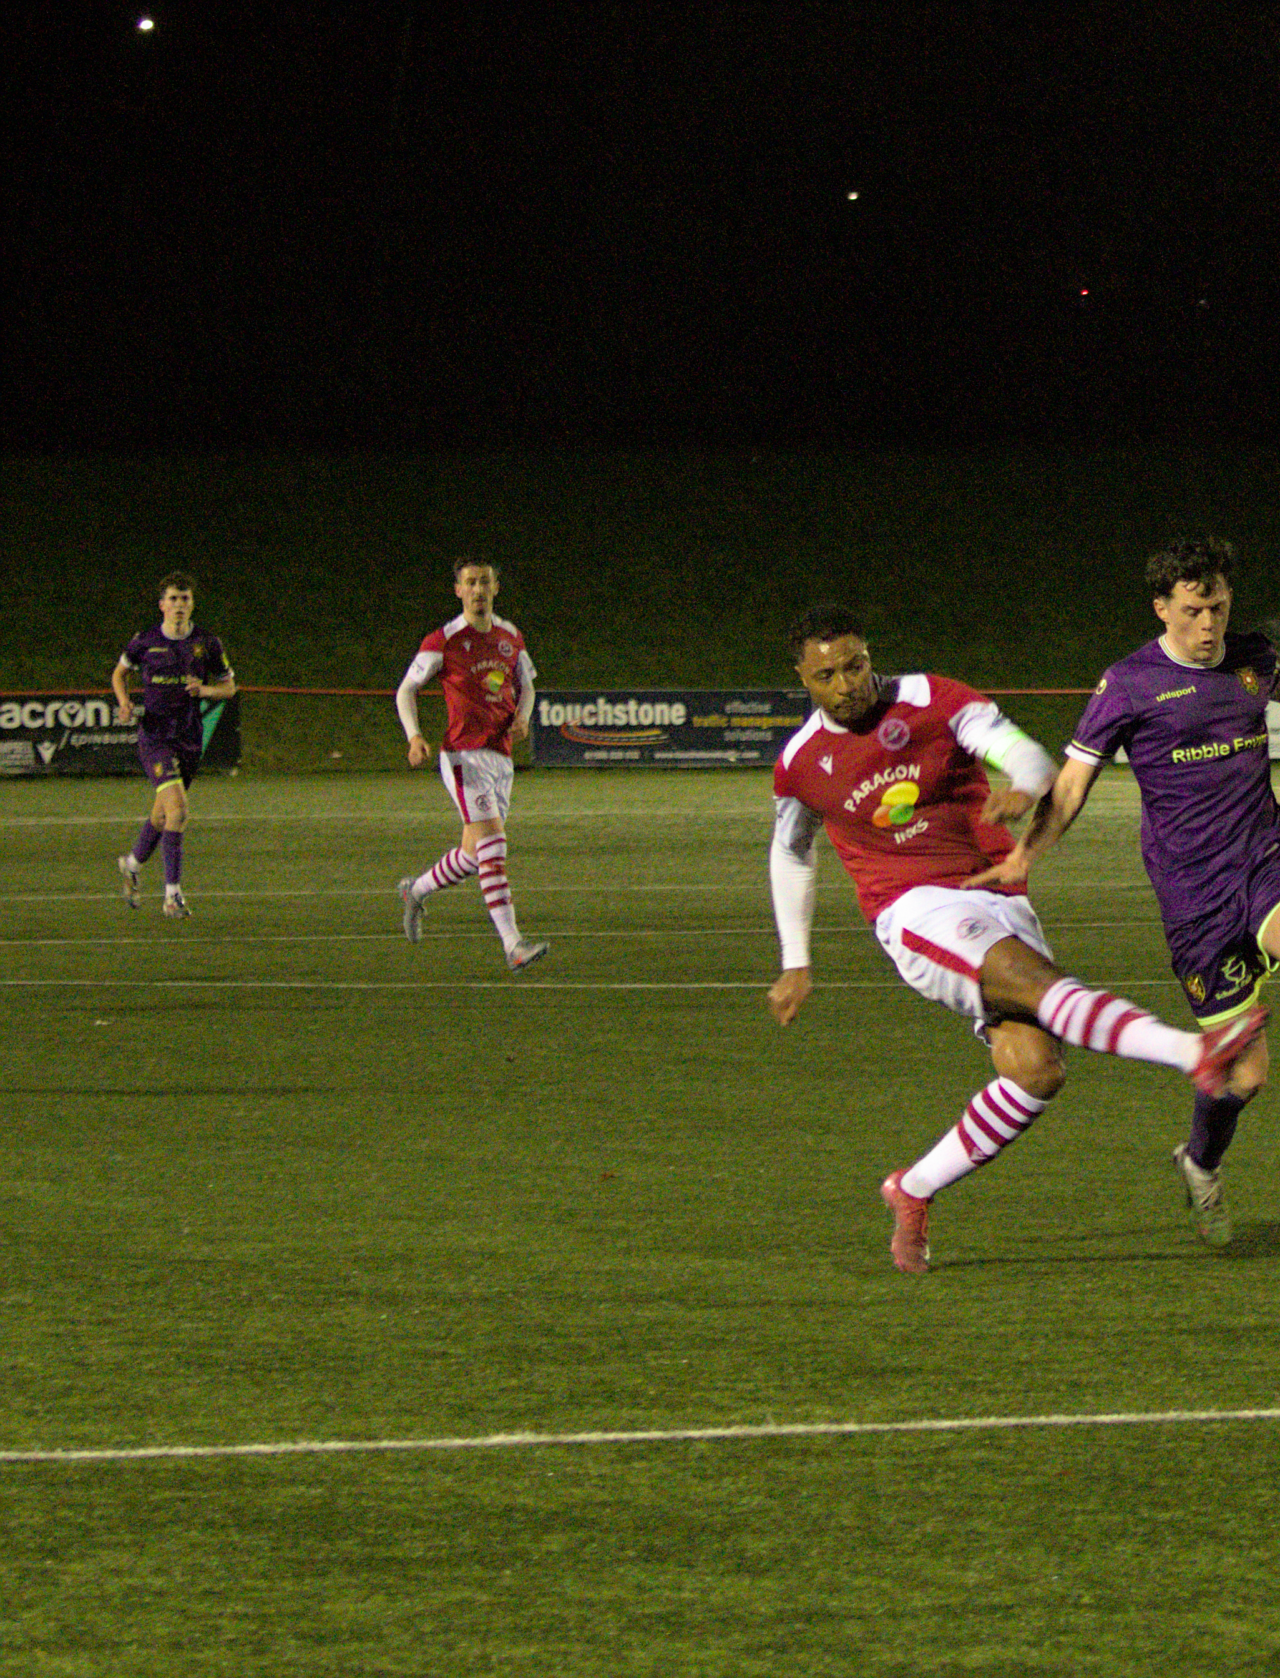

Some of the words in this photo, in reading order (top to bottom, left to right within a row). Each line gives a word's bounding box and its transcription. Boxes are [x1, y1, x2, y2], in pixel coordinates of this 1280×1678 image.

[1156, 685, 1197, 702] uhlsport
[538, 697, 687, 727] touchstone
[1171, 742, 1231, 764] Ribble
[843, 764, 921, 813] PARAGON
